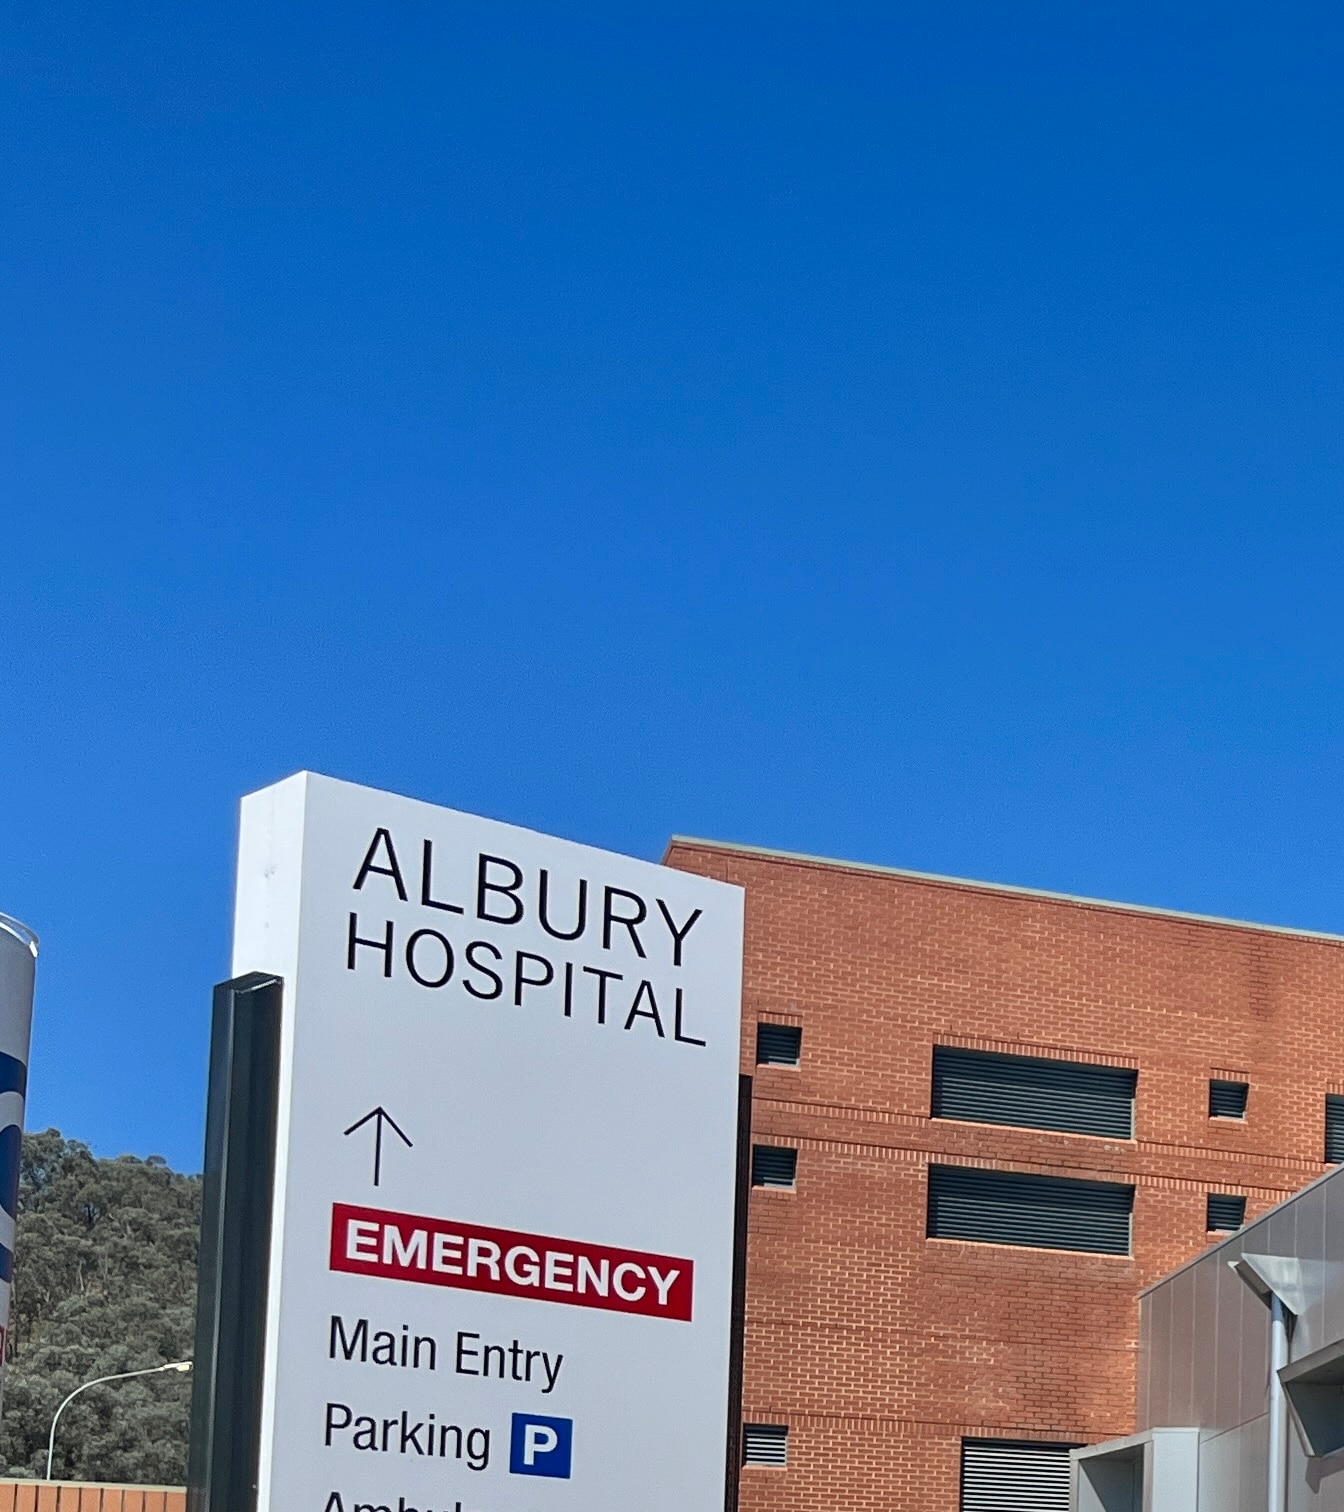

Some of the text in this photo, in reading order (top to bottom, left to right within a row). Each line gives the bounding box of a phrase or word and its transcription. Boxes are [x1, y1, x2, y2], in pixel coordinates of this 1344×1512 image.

[353, 827, 703, 966] ALBURY
[347, 912, 706, 1047] HOSPITAL
[345, 1219, 681, 1306] EMERGENCY
[329, 1315, 563, 1394] Main Entry
[324, 1403, 559, 1471] Parking P
